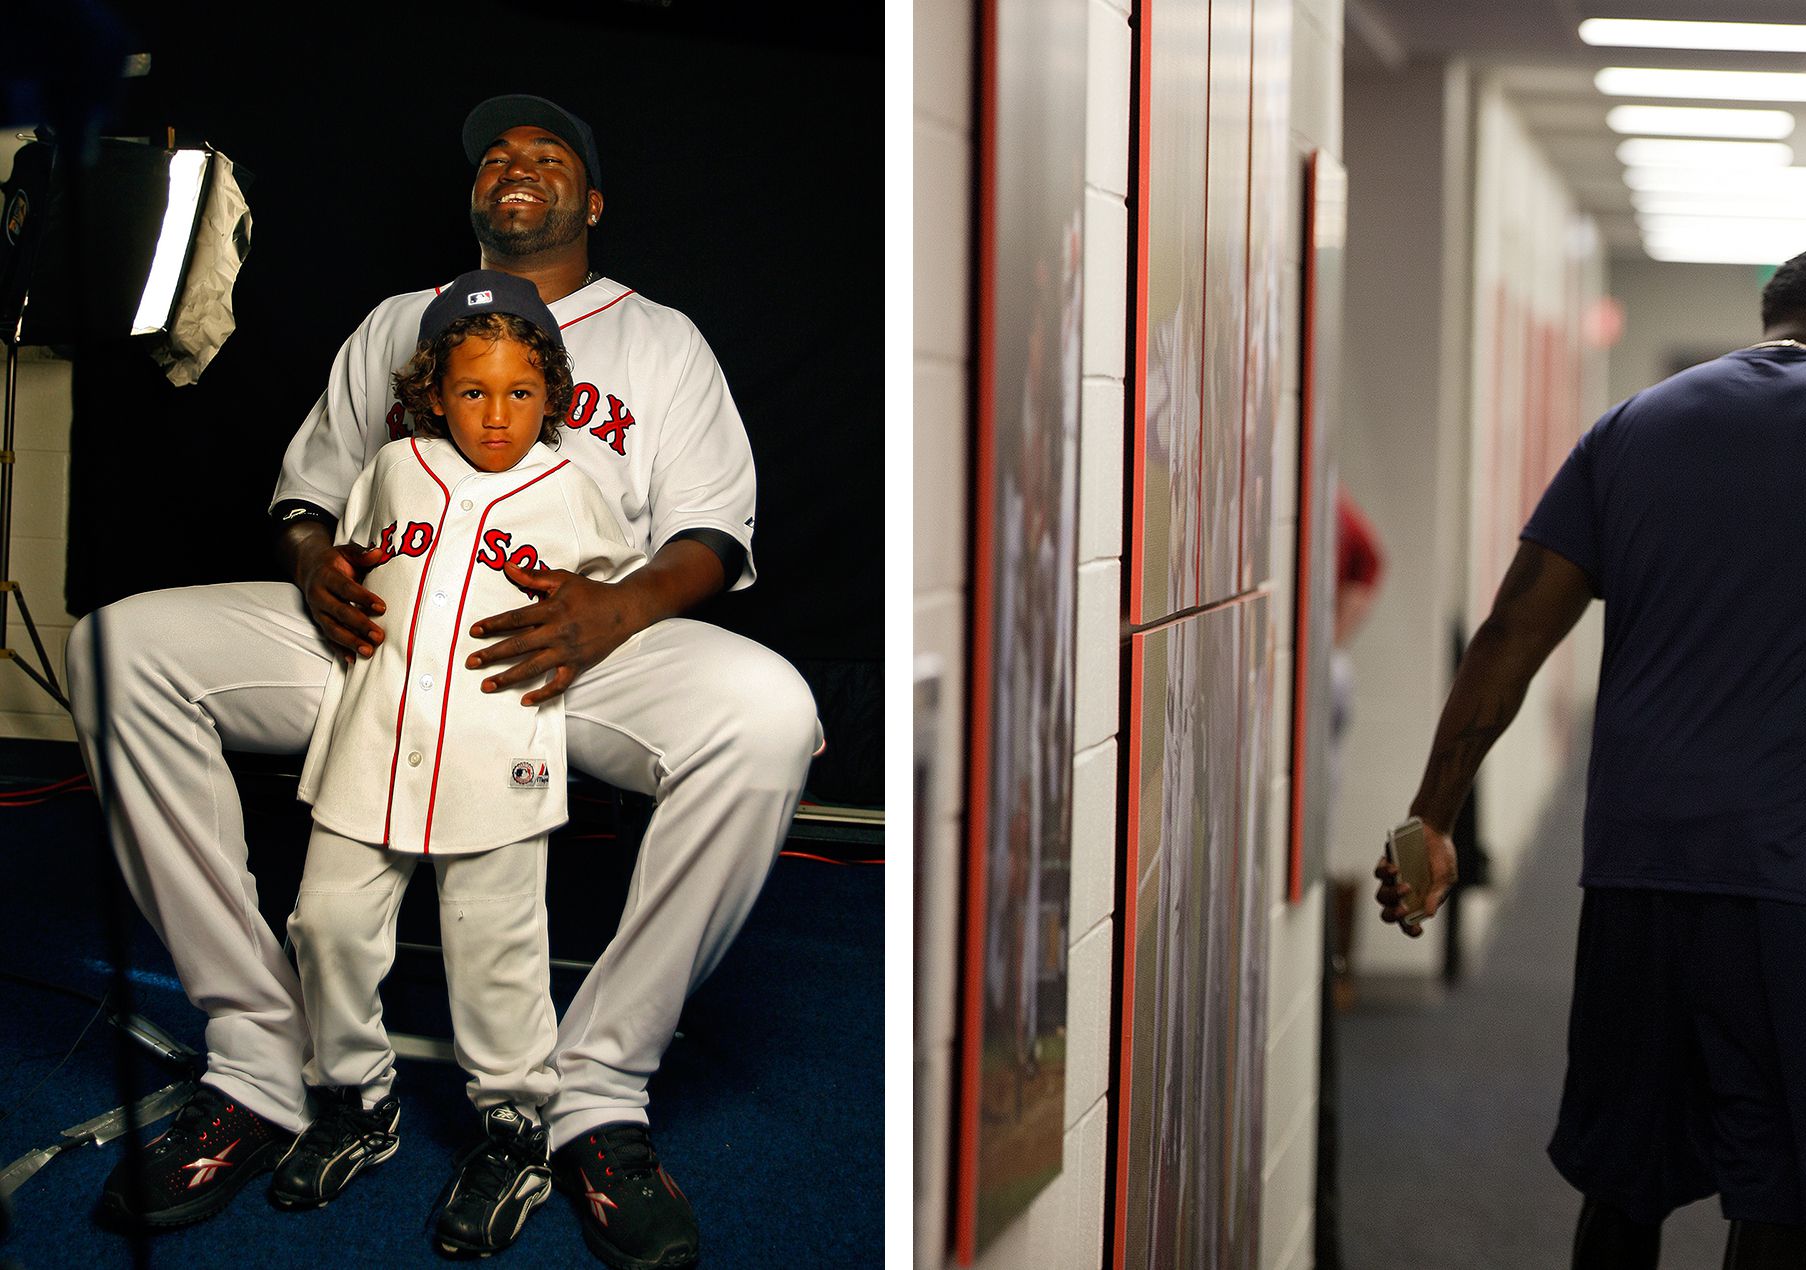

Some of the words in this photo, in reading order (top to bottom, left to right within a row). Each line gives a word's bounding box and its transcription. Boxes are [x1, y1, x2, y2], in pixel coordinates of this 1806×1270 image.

[564, 382, 636, 456] OX
[368, 520, 434, 568] ED
[476, 528, 550, 571] SO
